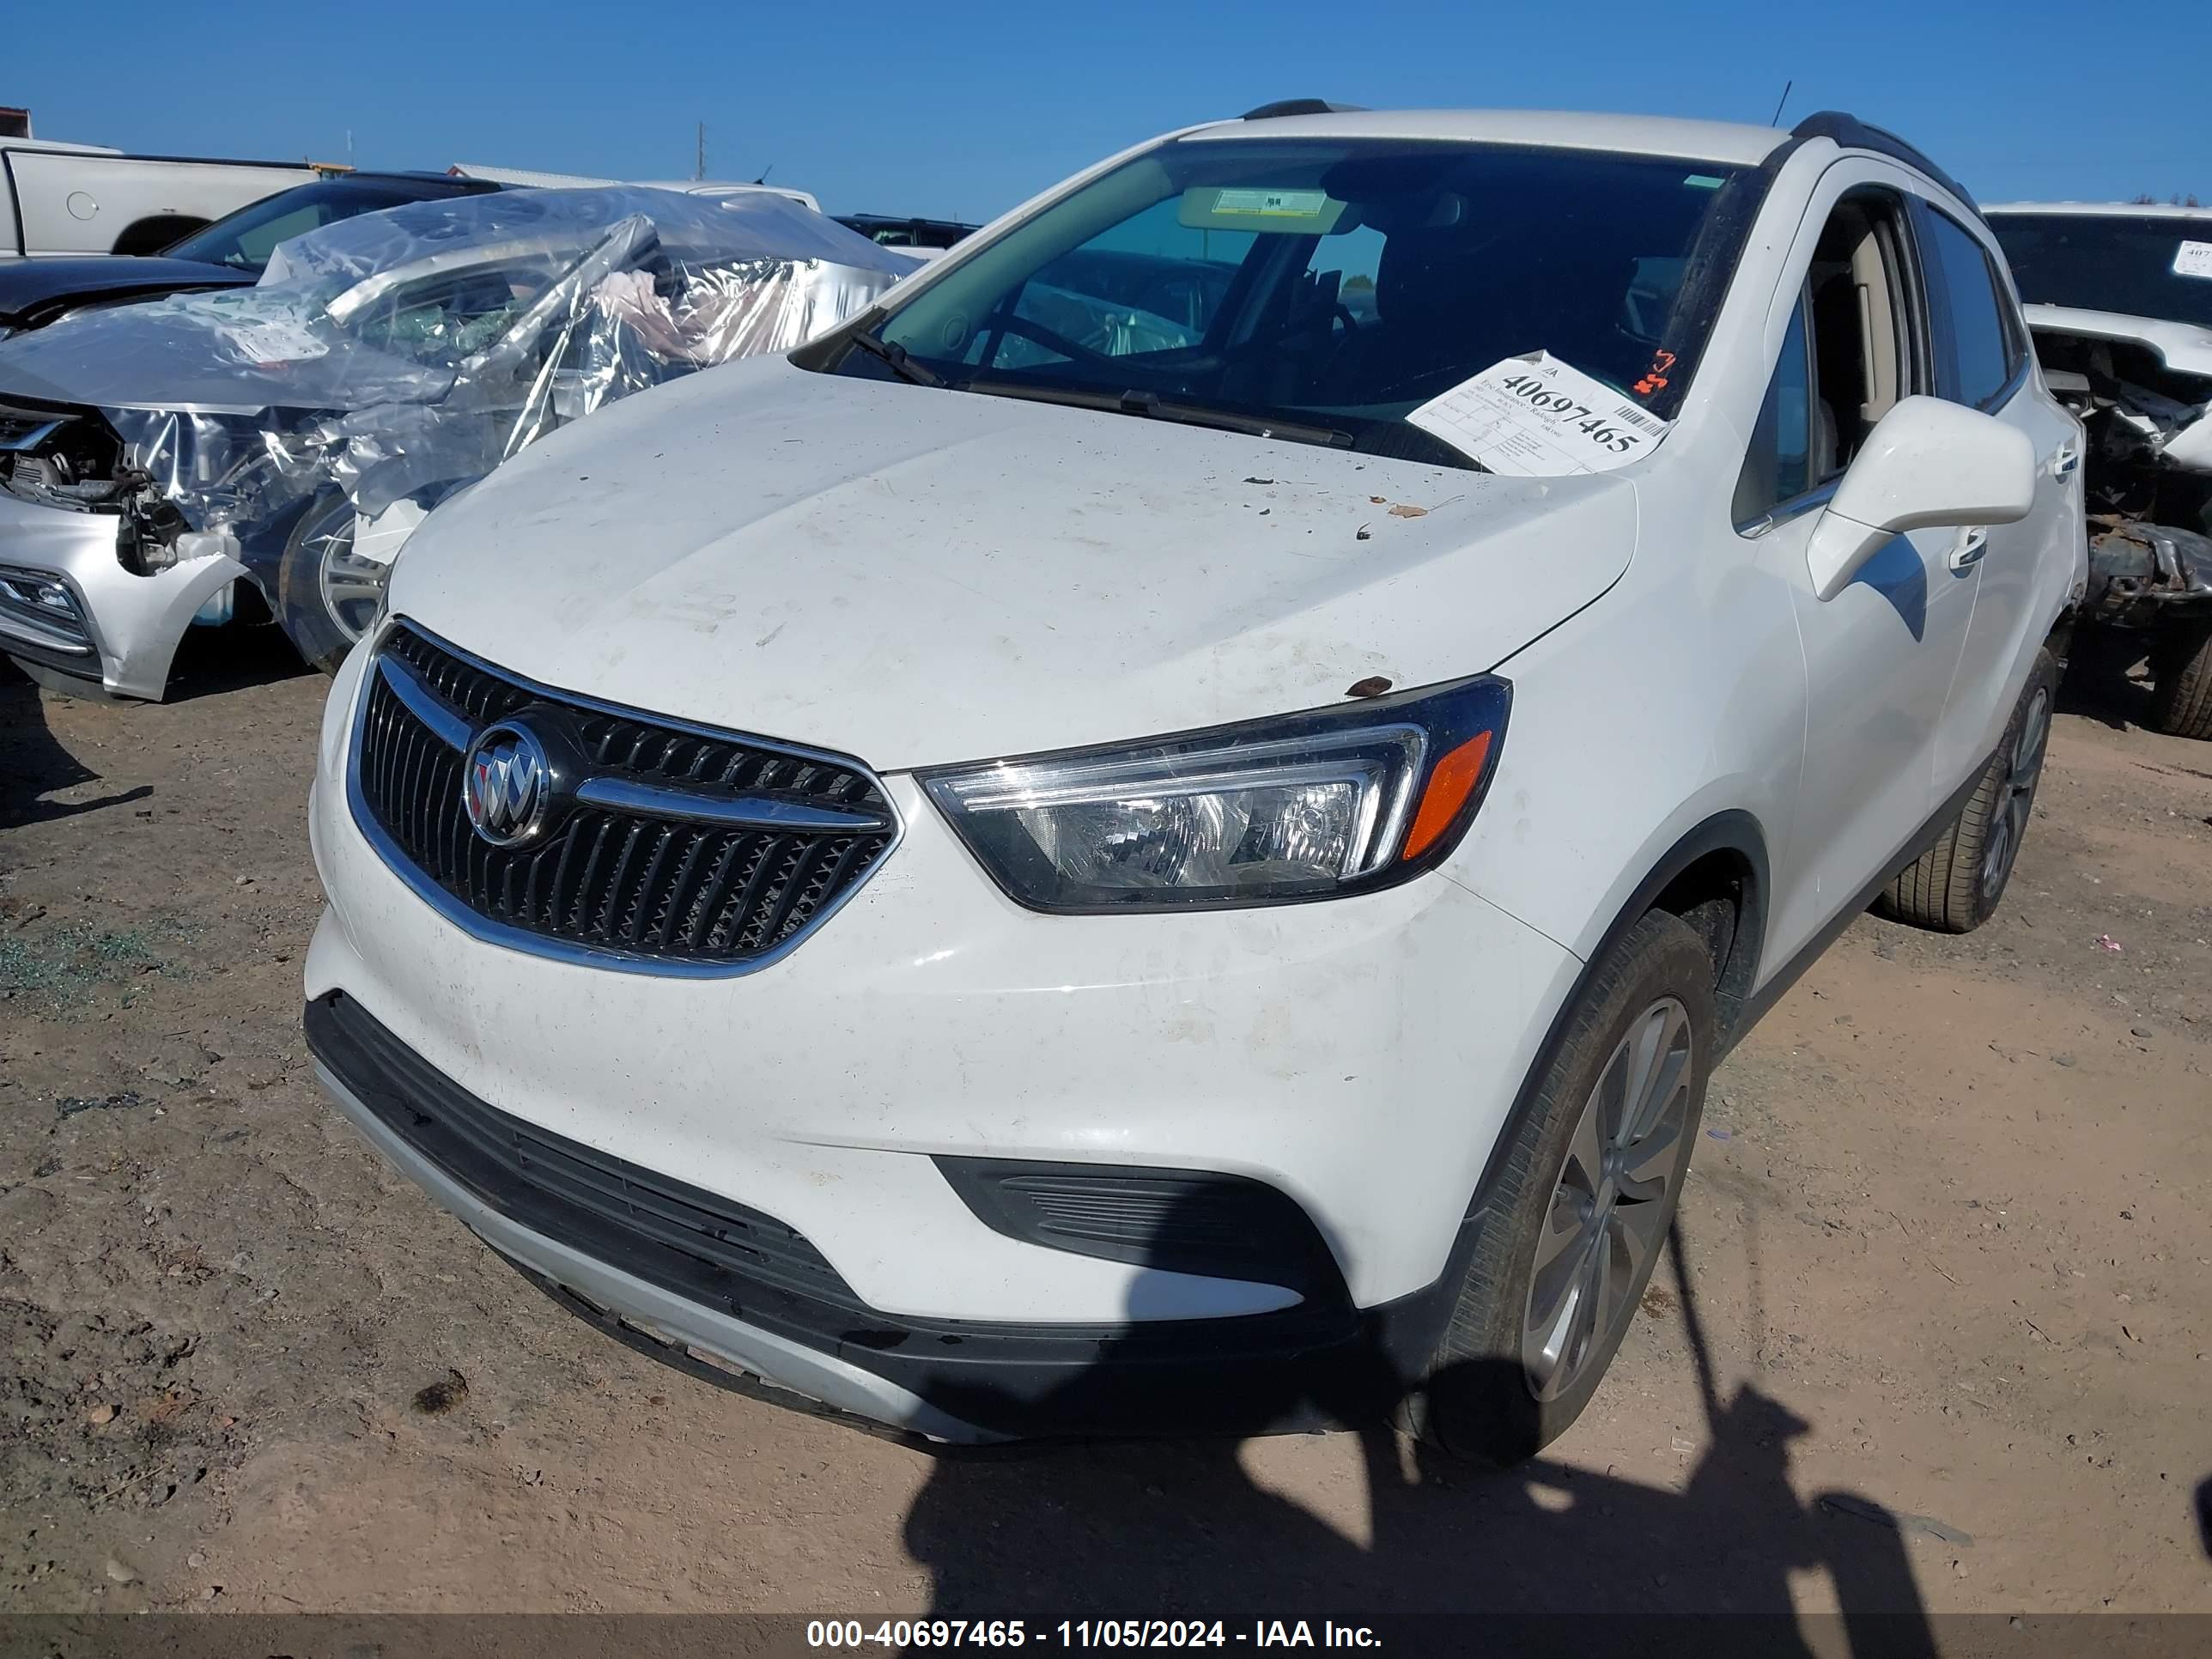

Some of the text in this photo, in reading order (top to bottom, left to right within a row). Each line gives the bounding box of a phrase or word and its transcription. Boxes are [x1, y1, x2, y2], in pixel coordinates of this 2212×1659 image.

[1494, 387, 1527, 408] Insurance
[1529, 407, 1558, 426] Raleigh
[1502, 375, 1640, 453] 40697465
